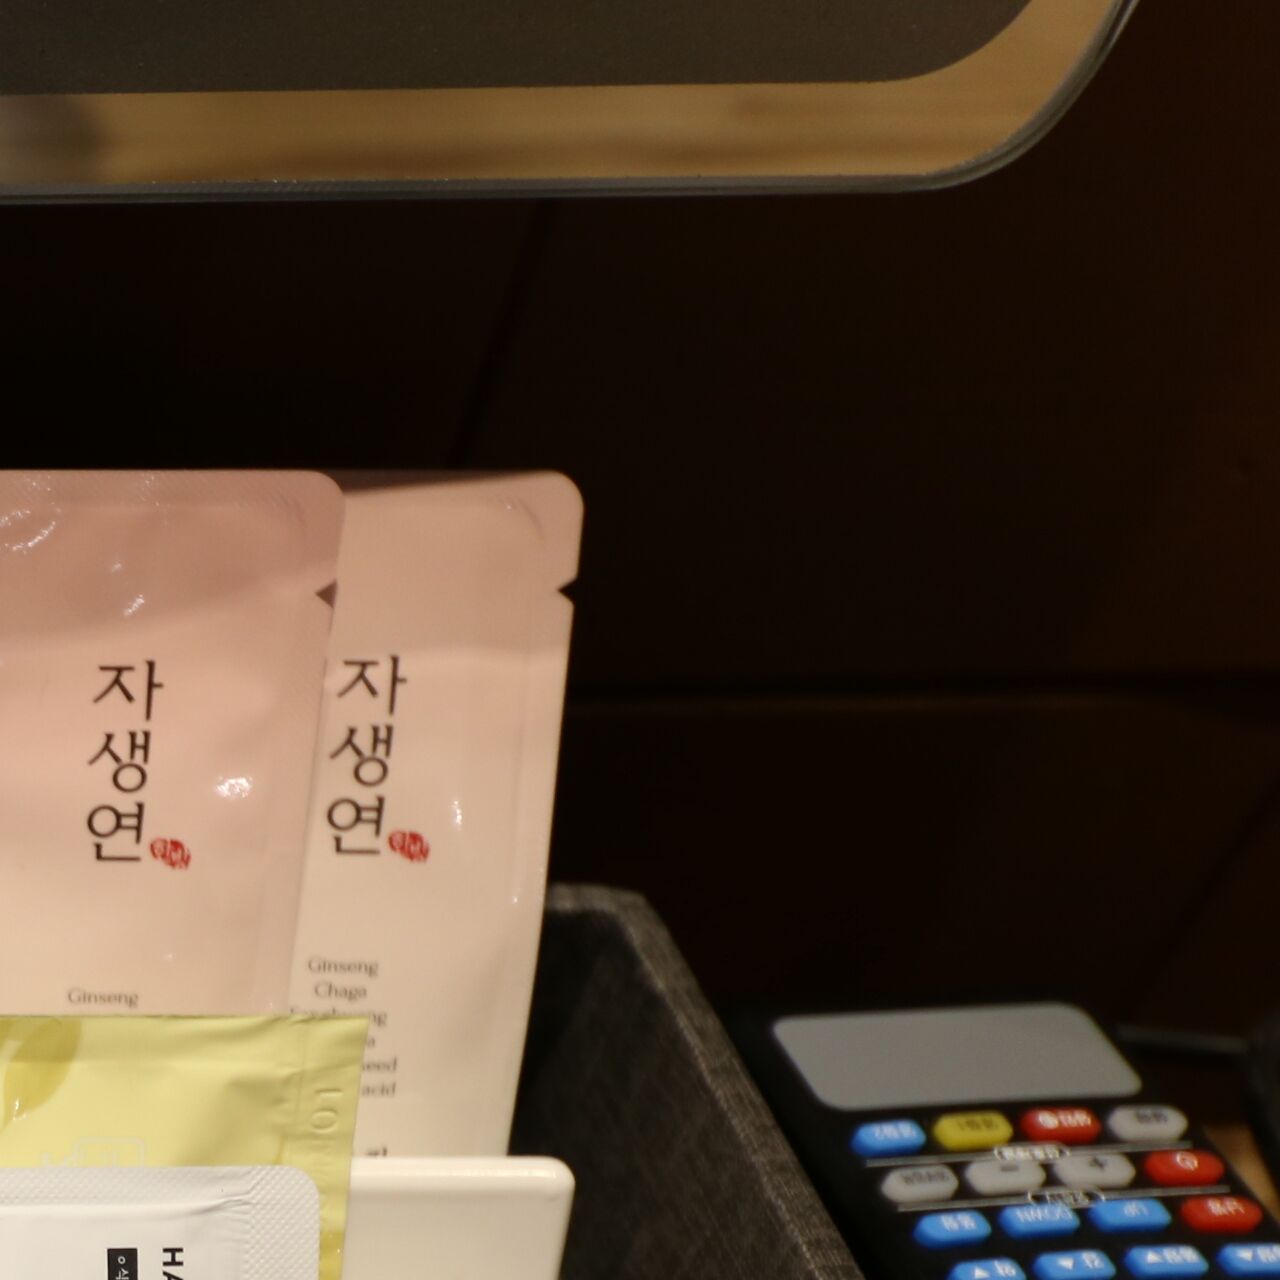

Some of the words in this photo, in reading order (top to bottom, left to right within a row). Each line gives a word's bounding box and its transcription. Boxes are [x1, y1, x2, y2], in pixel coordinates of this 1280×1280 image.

[86, 659, 165, 864] 자생연
[326, 653, 409, 857] 자생연
[307, 956, 380, 978] Ginseng
[67, 986, 140, 1009] Ginseng
[313, 980, 369, 1001] Chaga
